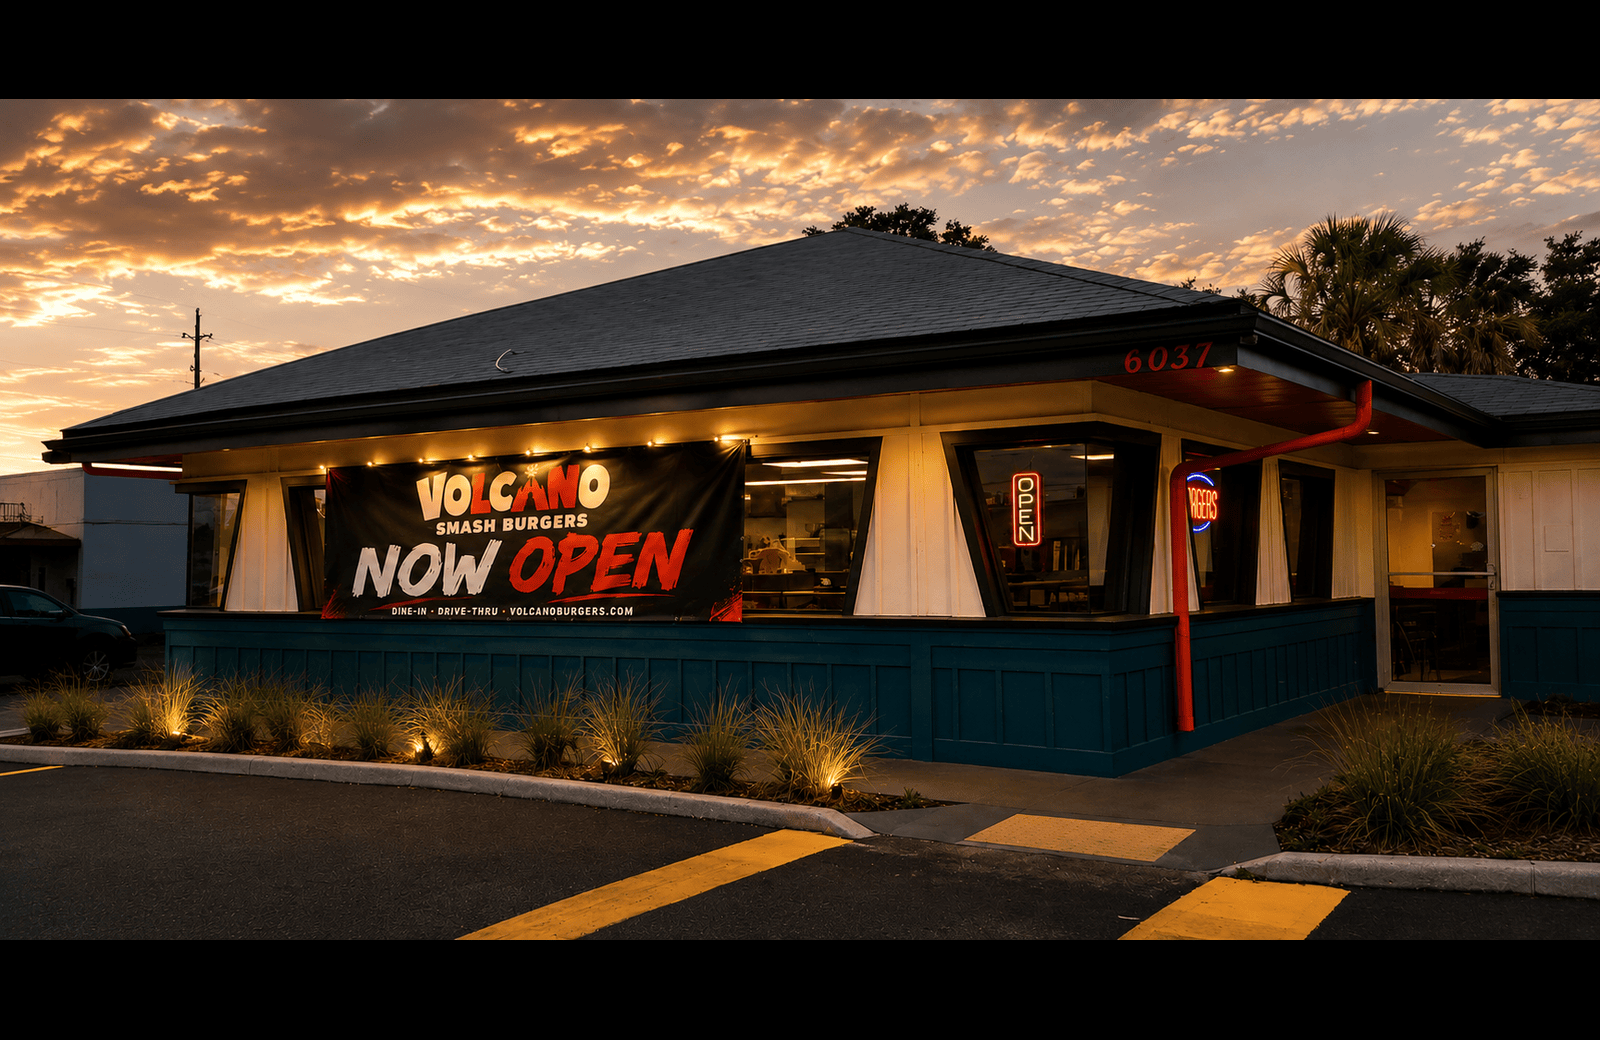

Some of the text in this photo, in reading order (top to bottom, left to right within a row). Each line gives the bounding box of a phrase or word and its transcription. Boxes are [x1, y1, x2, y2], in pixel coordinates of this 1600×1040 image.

[1124, 341, 1213, 374] 6037
[415, 464, 611, 521] VOLCANO
[1018, 477, 1034, 542] OPEN
[1187, 486, 1218, 520] RGERS
[435, 513, 588, 536] SMASH BURGERS
[352, 528, 694, 597] NOW OPEN
[391, 606, 633, 616] DINE-IN DRIVE-THRU VOLCANOBURGERS.COM
